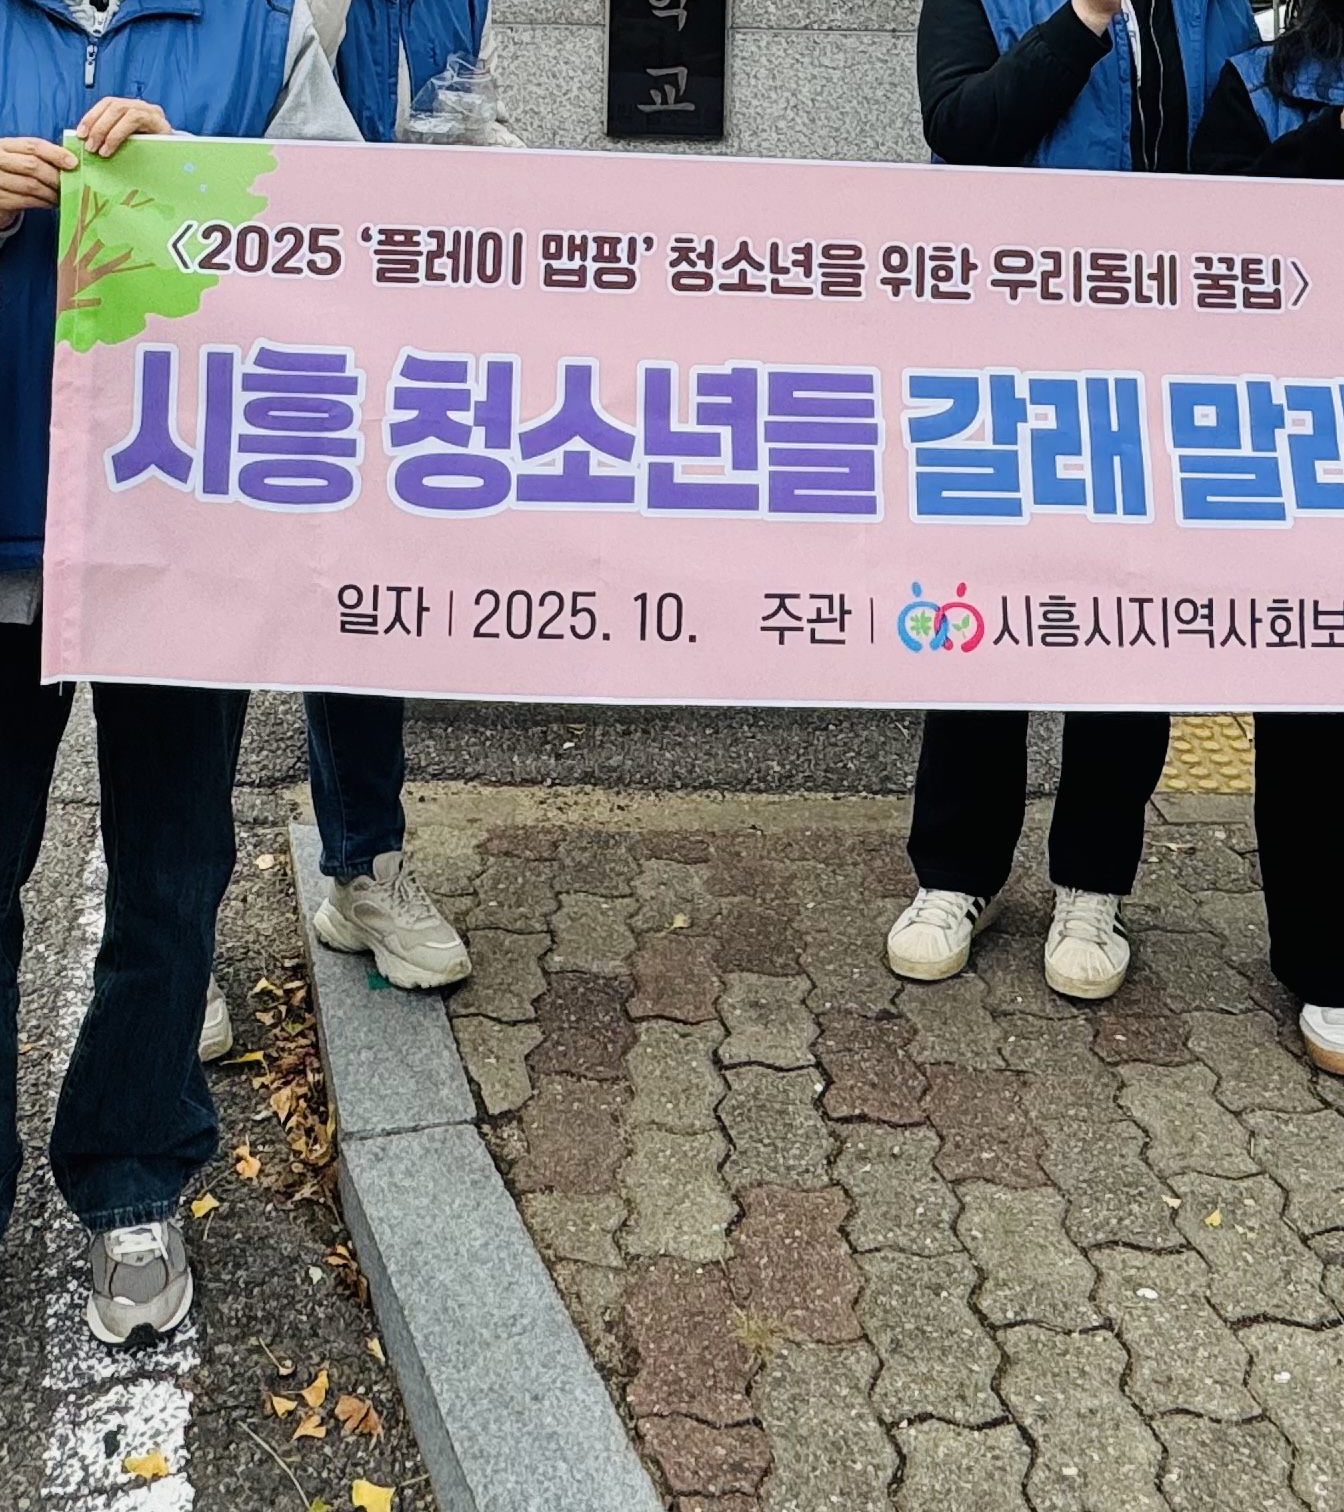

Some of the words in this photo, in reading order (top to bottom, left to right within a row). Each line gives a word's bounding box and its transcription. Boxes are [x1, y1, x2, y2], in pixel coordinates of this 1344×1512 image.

[669, 237, 866, 299] 청소년을
[880, 245, 979, 300] 위한
[990, 249, 1178, 307] 우리동네
[111, 347, 359, 506] 시흥
[389, 354, 880, 515] 청소년들
[906, 373, 1150, 519] 갈래
[336, 584, 431, 638] 일자
[473, 589, 612, 642] 2025.
[632, 592, 698, 643] 10.
[760, 593, 853, 646] 주관
